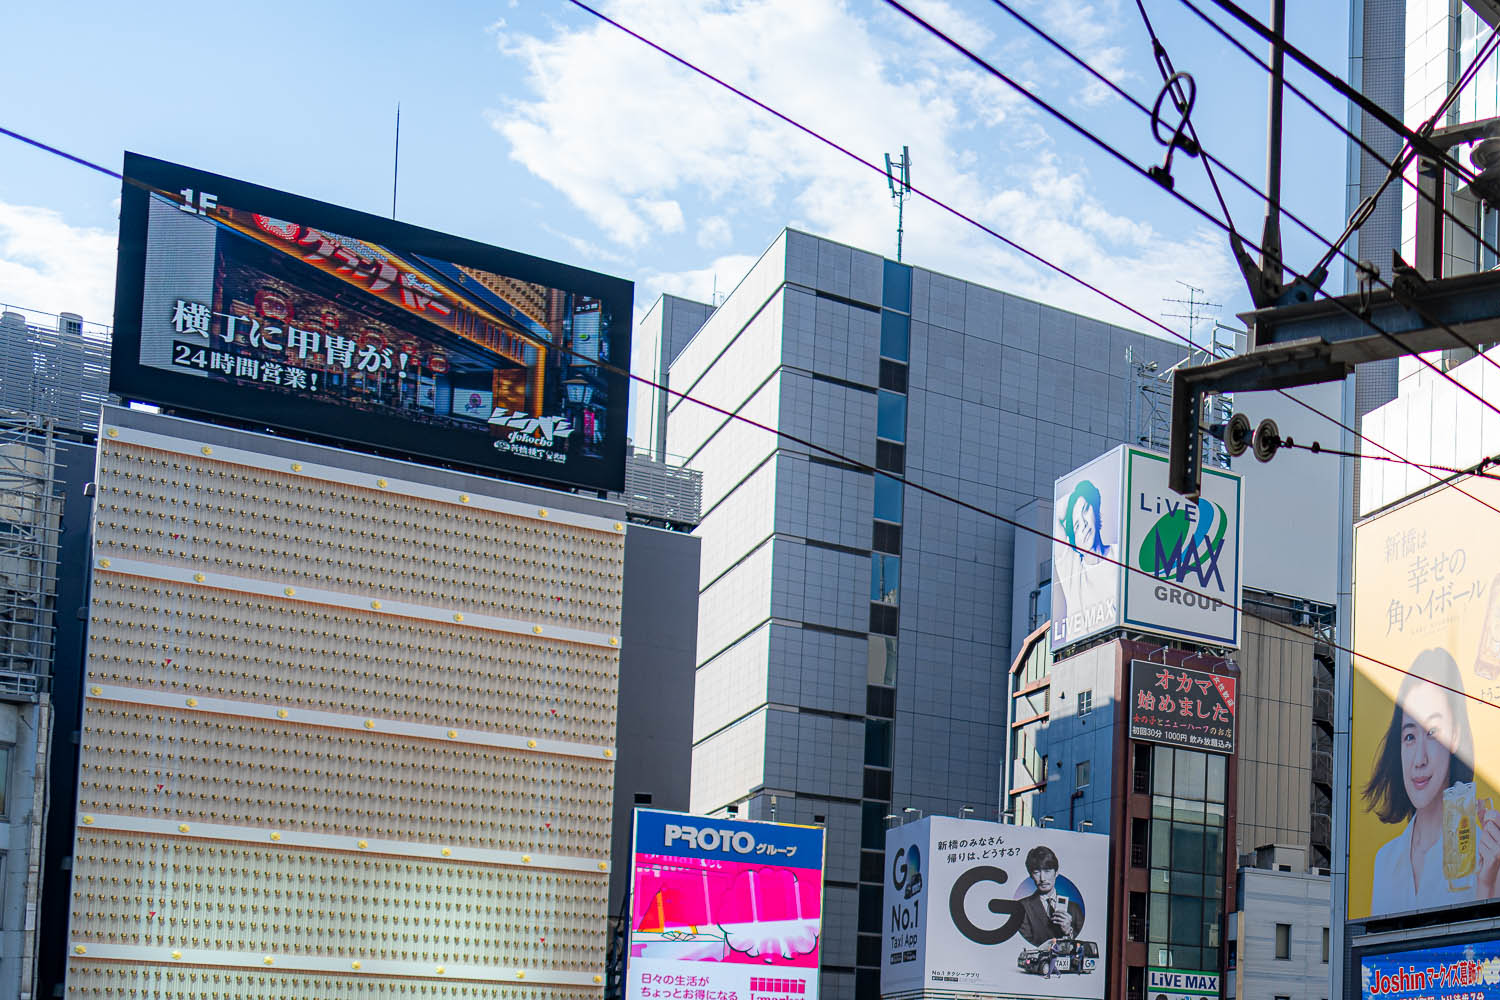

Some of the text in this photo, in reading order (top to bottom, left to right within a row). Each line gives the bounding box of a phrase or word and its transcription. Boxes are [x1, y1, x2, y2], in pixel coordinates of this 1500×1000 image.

[179, 188, 218, 216] 1F
[1153, 526, 1226, 592] MAX
[1384, 527, 1428, 564] 新橋は
[1408, 548, 1466, 594] 幸せの
[1154, 585, 1223, 612] GROUP
[1385, 580, 1488, 638] 角ハイボール
[1155, 668, 1213, 695] オカマ
[1137, 690, 1230, 723] 始めました
[1165, 731, 1187, 742] 1000円
[664, 824, 798, 857] PROTO グループ
[937, 835, 1005, 851] 新橋のみなさん
[890, 900, 920, 933] No.1
[891, 932, 918, 949] Taxi App
[1055, 958, 1069, 968] TAXI
[641, 973, 710, 986] 日々の生活が
[1185, 975, 1217, 990] MAX
[1370, 966, 1425, 994] Joshin
